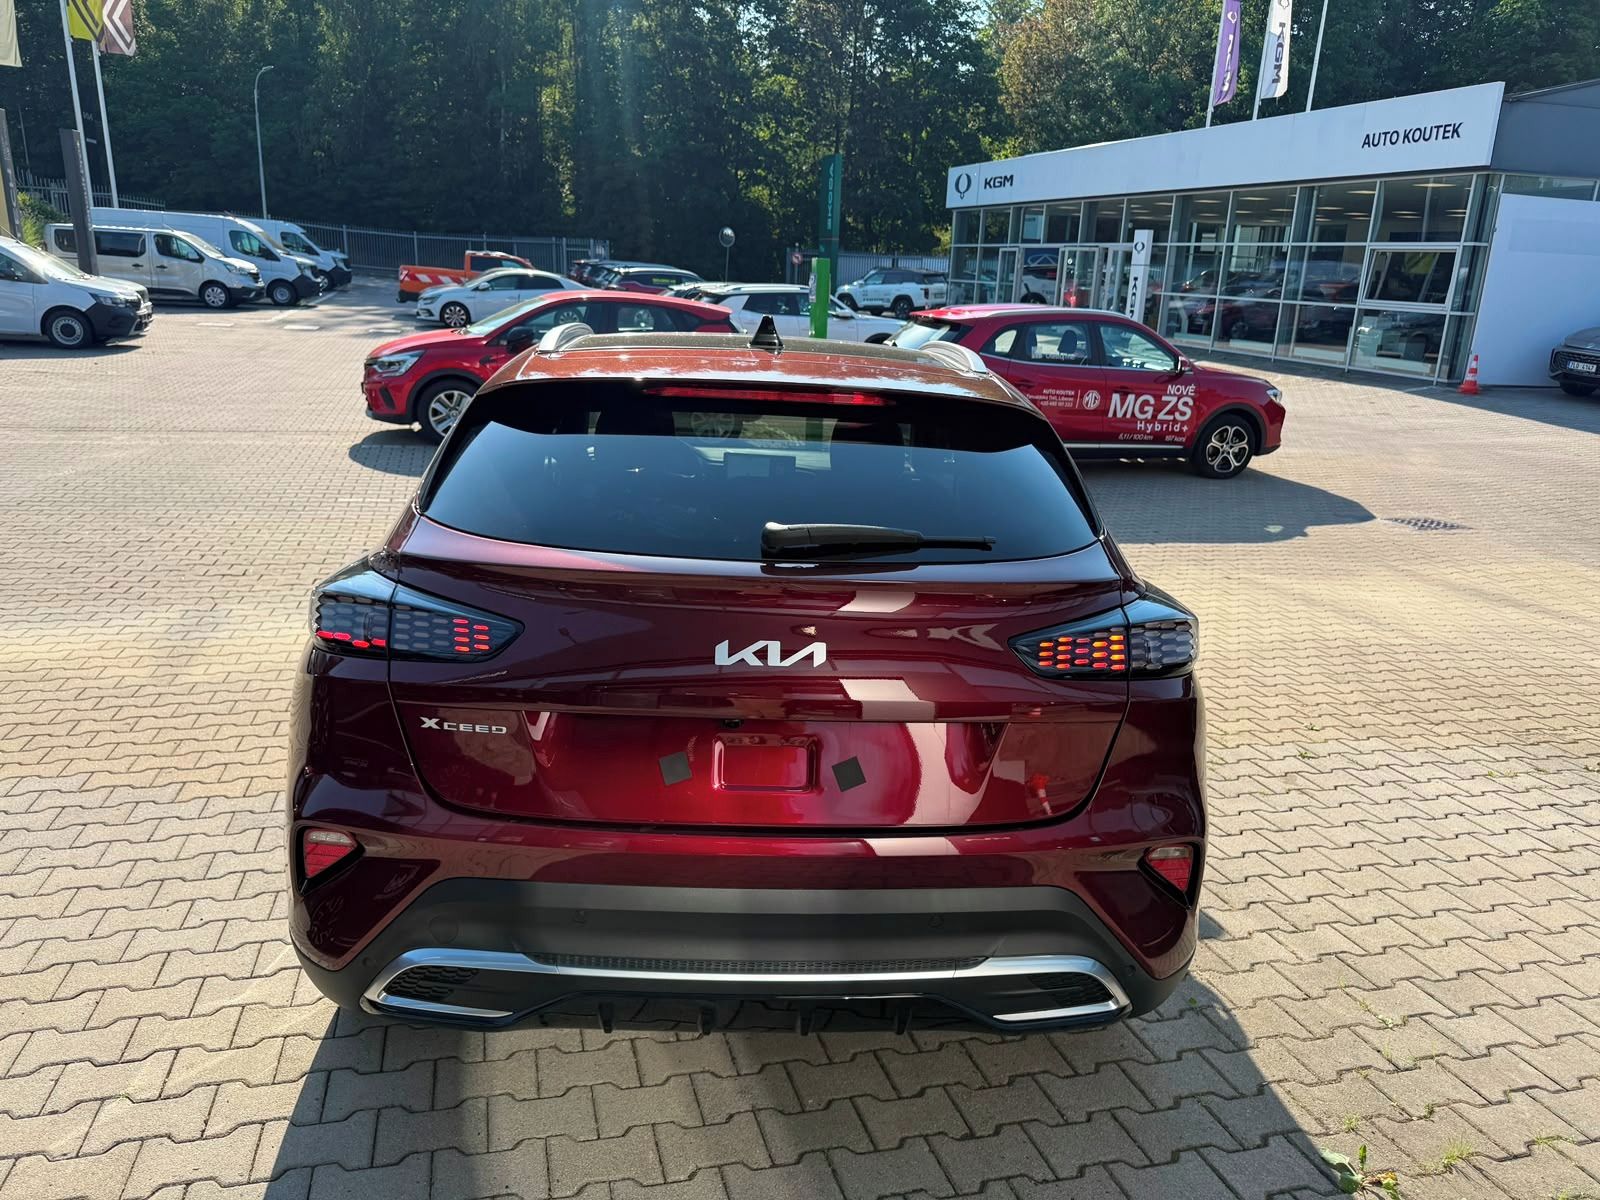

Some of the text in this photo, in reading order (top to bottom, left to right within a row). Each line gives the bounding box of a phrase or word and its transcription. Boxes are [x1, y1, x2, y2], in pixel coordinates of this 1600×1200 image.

[1272, 22, 1286, 84] KGM
[1361, 122, 1464, 149] AUTO KOUTEK
[984, 174, 1014, 190] KGM
[1083, 390, 1100, 409] MG
[1167, 384, 1196, 396] NOVÉ
[1107, 393, 1194, 421] MG ZS
[1137, 421, 1189, 433] Hybrid+
[714, 639, 827, 668] KIA
[420, 716, 507, 734] XCEED
